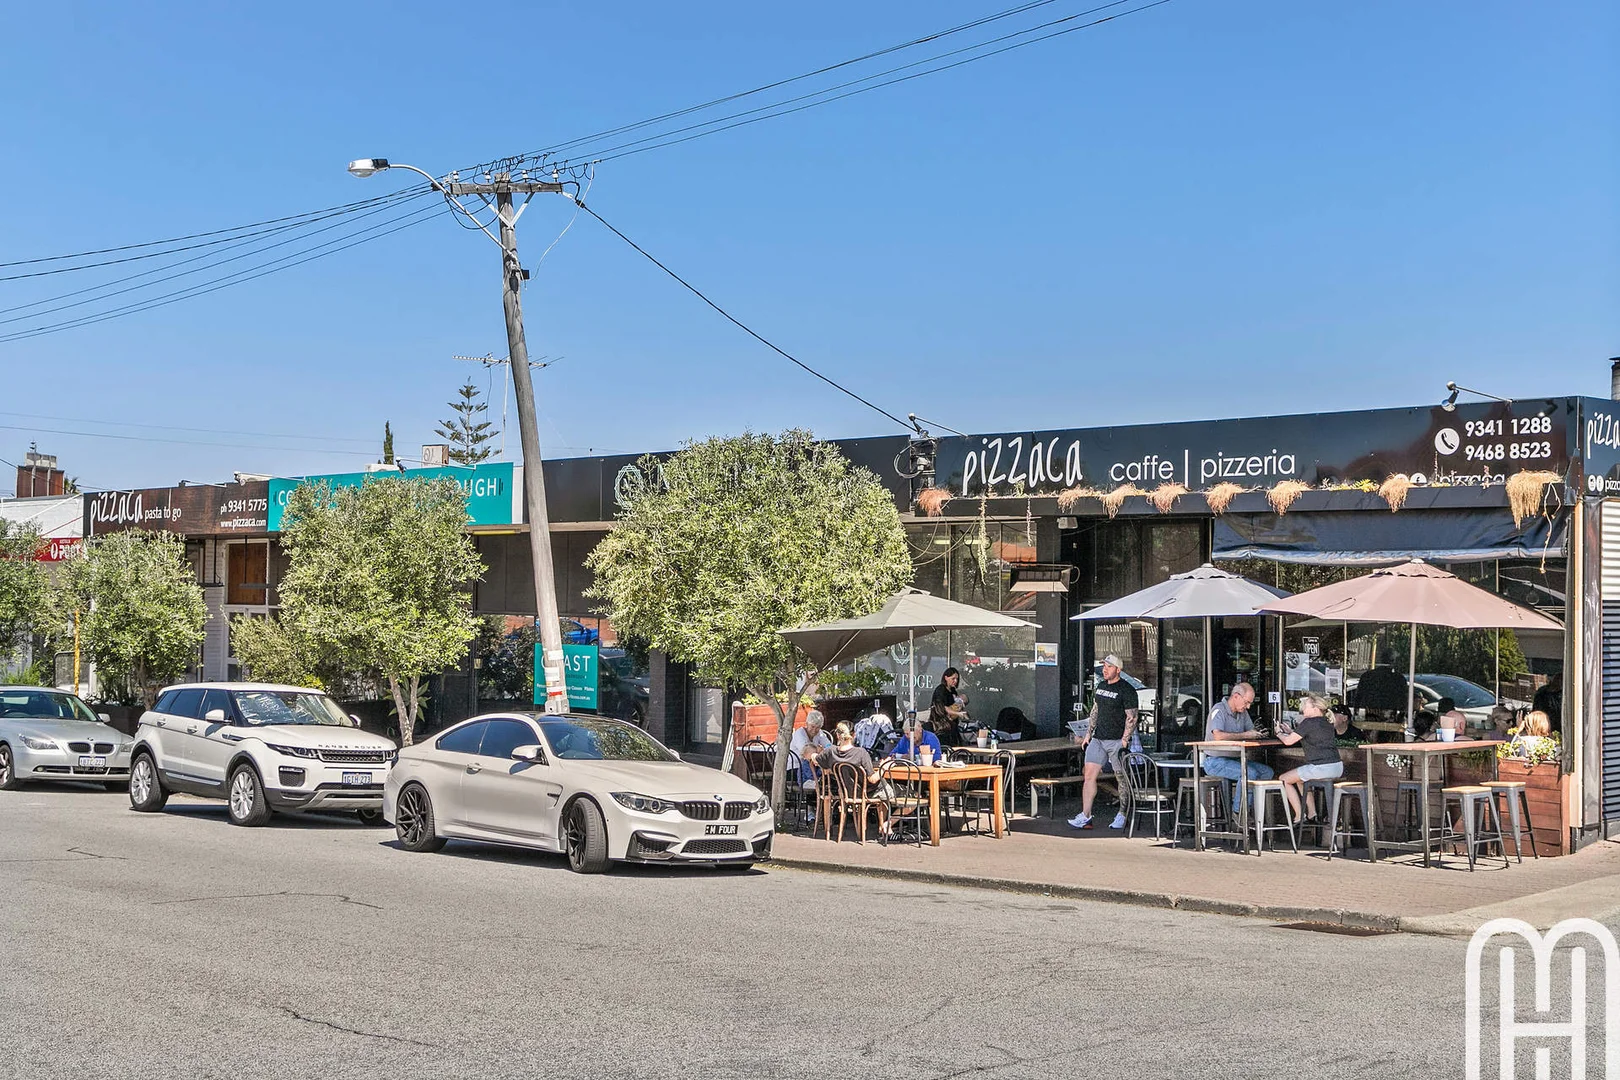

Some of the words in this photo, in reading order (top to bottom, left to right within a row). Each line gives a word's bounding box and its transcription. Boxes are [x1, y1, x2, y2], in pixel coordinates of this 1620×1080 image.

[1465, 419, 1504, 438] 9341
[1511, 416, 1552, 435] 1288
[1465, 444, 1505, 461] 9468
[1510, 441, 1551, 459] 8523
[1110, 455, 1174, 482] caffe
[1201, 448, 1296, 481] pizzeria
[144, 506, 162, 523] pasta
[163, 505, 171, 519] to
[172, 507, 182, 522] go
[220, 503, 228, 515] ph
[228, 500, 246, 513] 9341
[248, 498, 267, 512] 5775
[220, 515, 267, 531] www.pizzaca.com
[710, 825, 716, 834] M
[719, 825, 736, 834] FOUR
